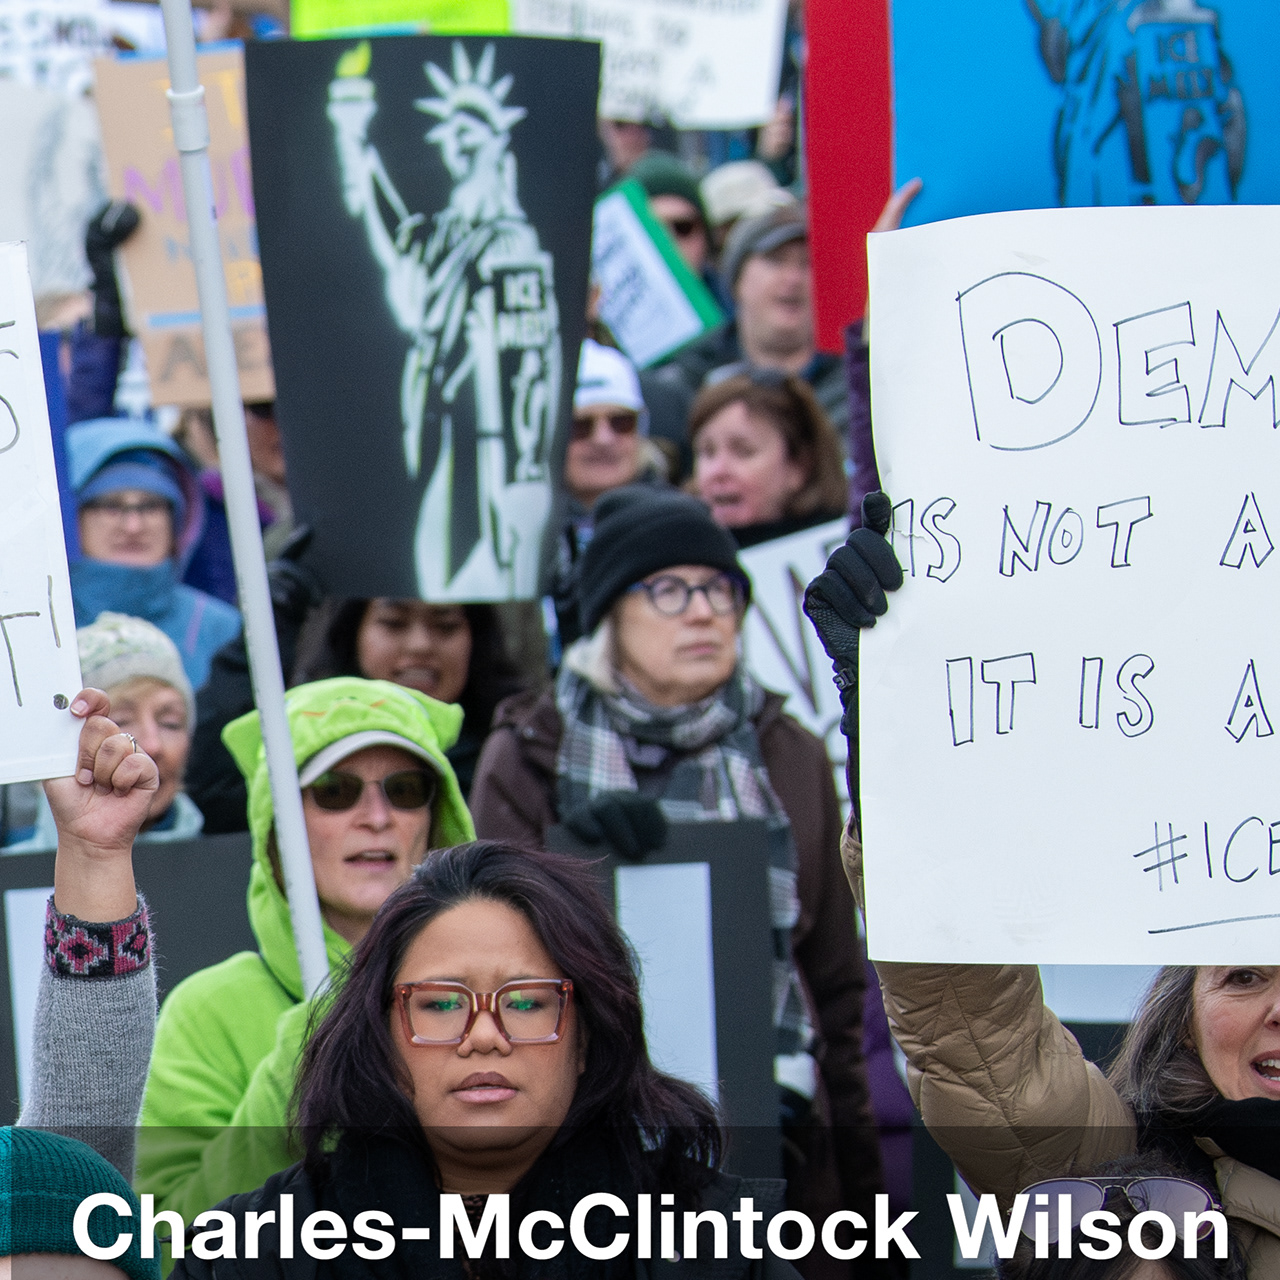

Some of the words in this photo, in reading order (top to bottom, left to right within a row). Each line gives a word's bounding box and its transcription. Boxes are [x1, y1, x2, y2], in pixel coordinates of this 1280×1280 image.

[891, 497, 961, 583] IS
[999, 496, 1153, 578] NOT
[946, 652, 1037, 746] IT
[1079, 653, 1155, 738] IS
